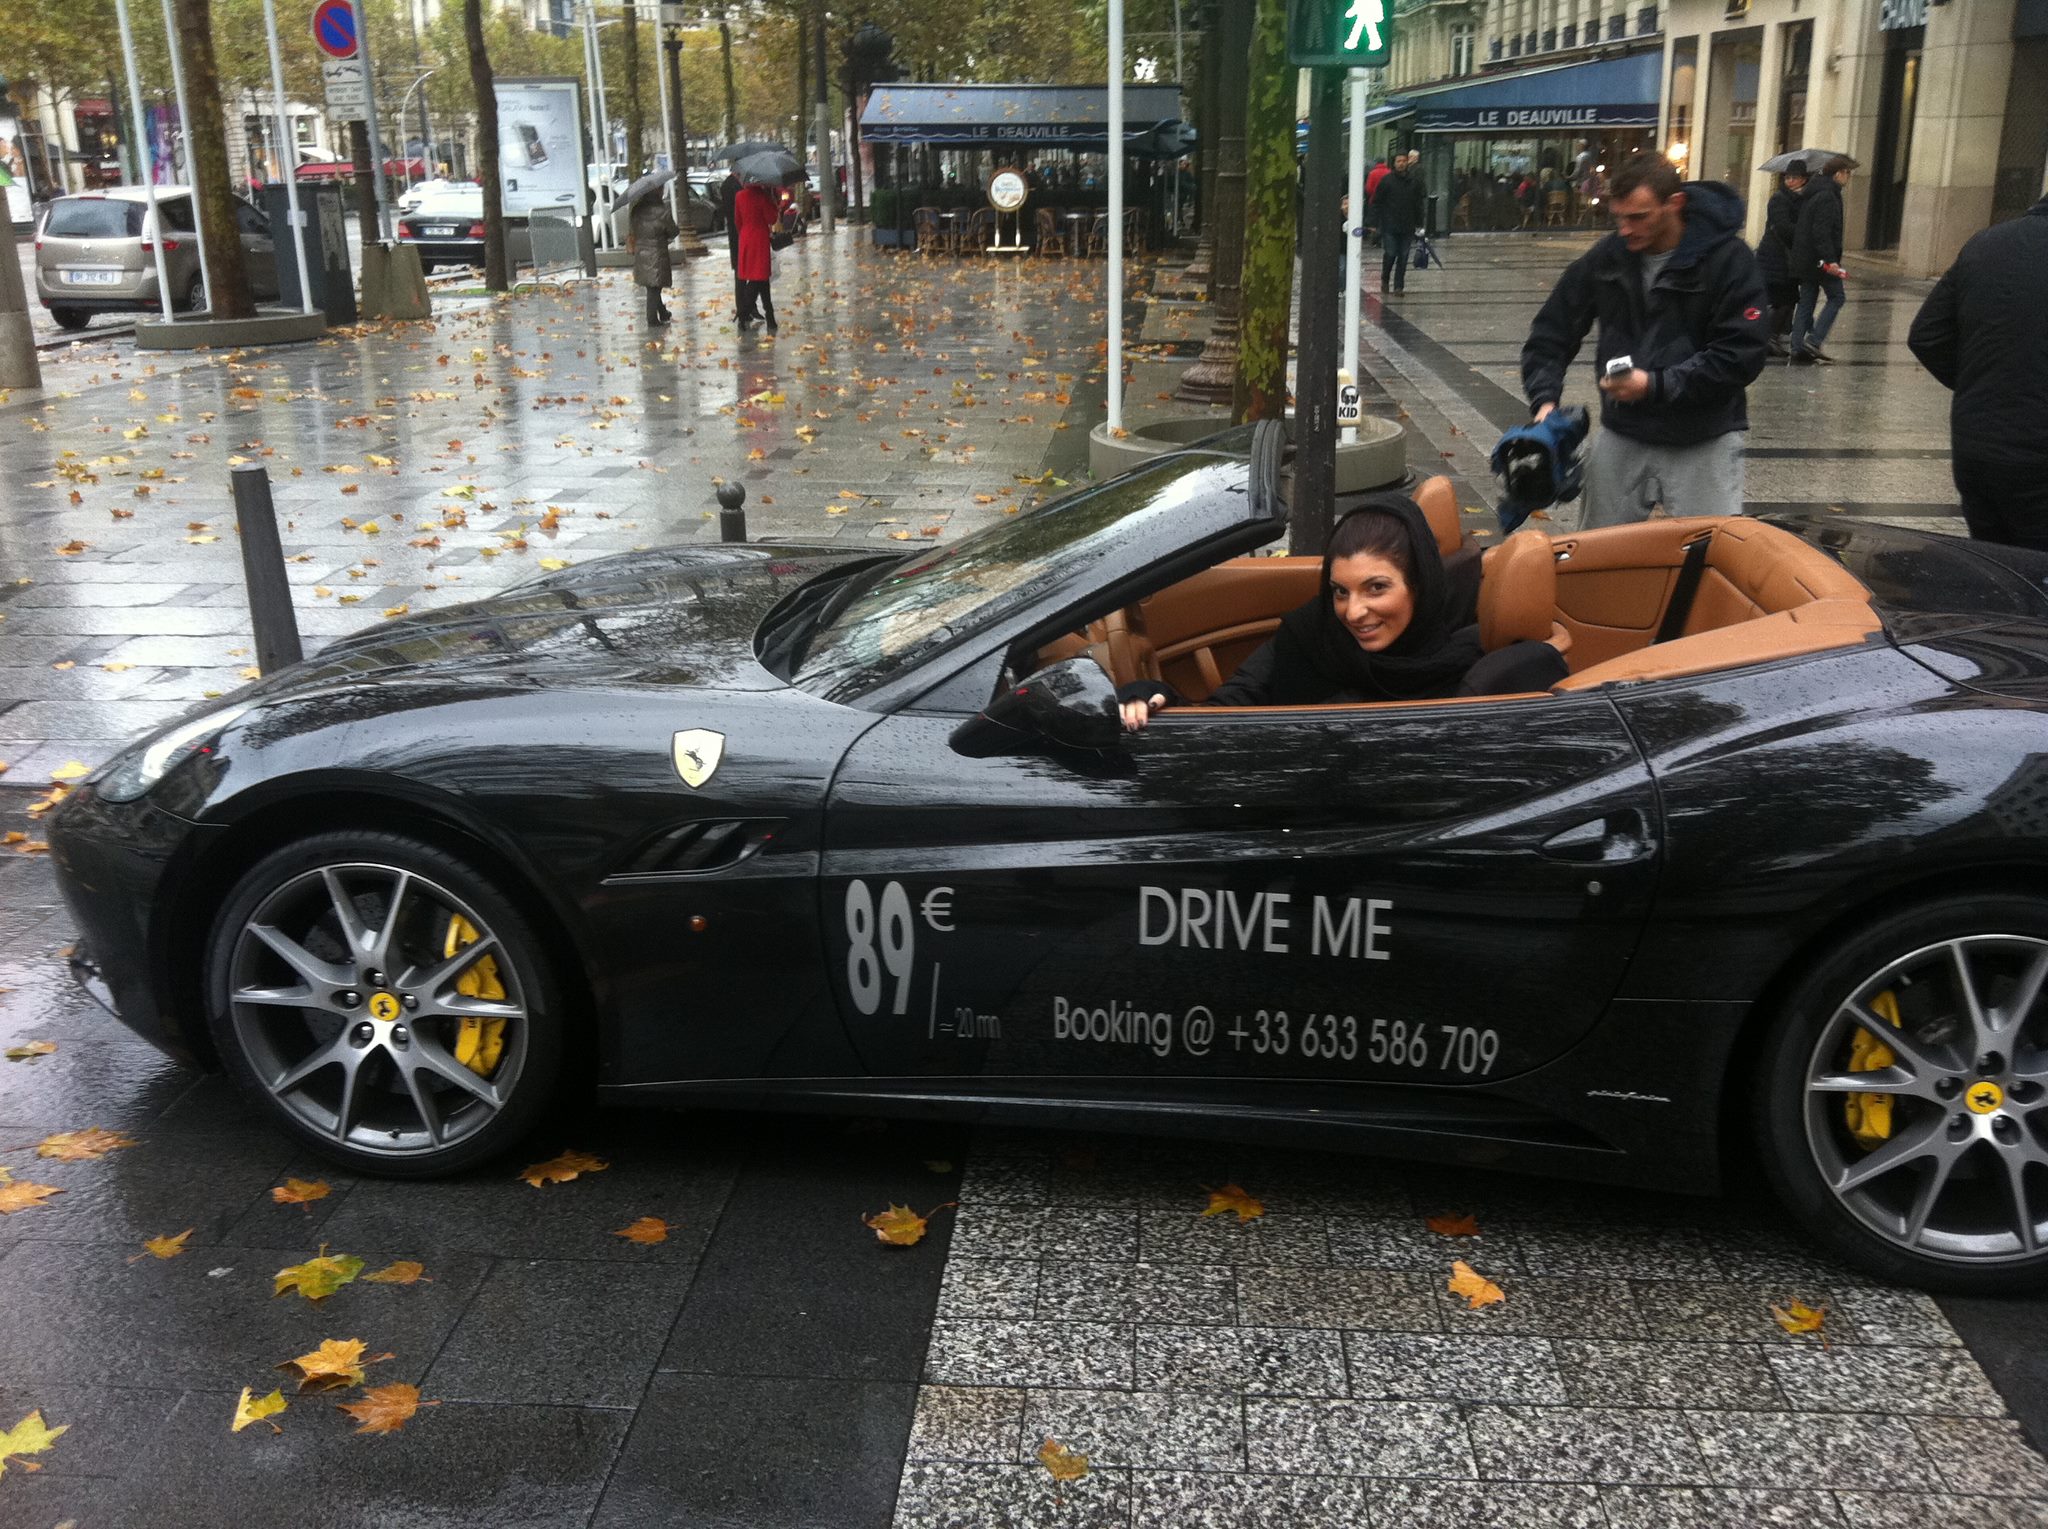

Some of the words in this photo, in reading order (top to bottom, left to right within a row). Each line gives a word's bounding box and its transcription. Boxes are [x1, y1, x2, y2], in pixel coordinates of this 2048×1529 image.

[972, 126, 989, 138] LE
[997, 126, 1069, 138] DEAUVILLE
[1478, 111, 1499, 126] LE
[1507, 109, 1597, 126] DEAUVILLE
[1338, 406, 1358, 418] KID
[1139, 886, 1290, 953] DRIVE
[1311, 895, 1394, 960] ME
[845, 879, 915, 1015] 89
[1054, 996, 1172, 1057] Booking
[1182, 1005, 1215, 1055] @
[1227, 1009, 1290, 1055] +33
[1301, 1013, 1358, 1061] 633
[1368, 1019, 1427, 1068] 586
[1440, 1025, 1499, 1075] 709
